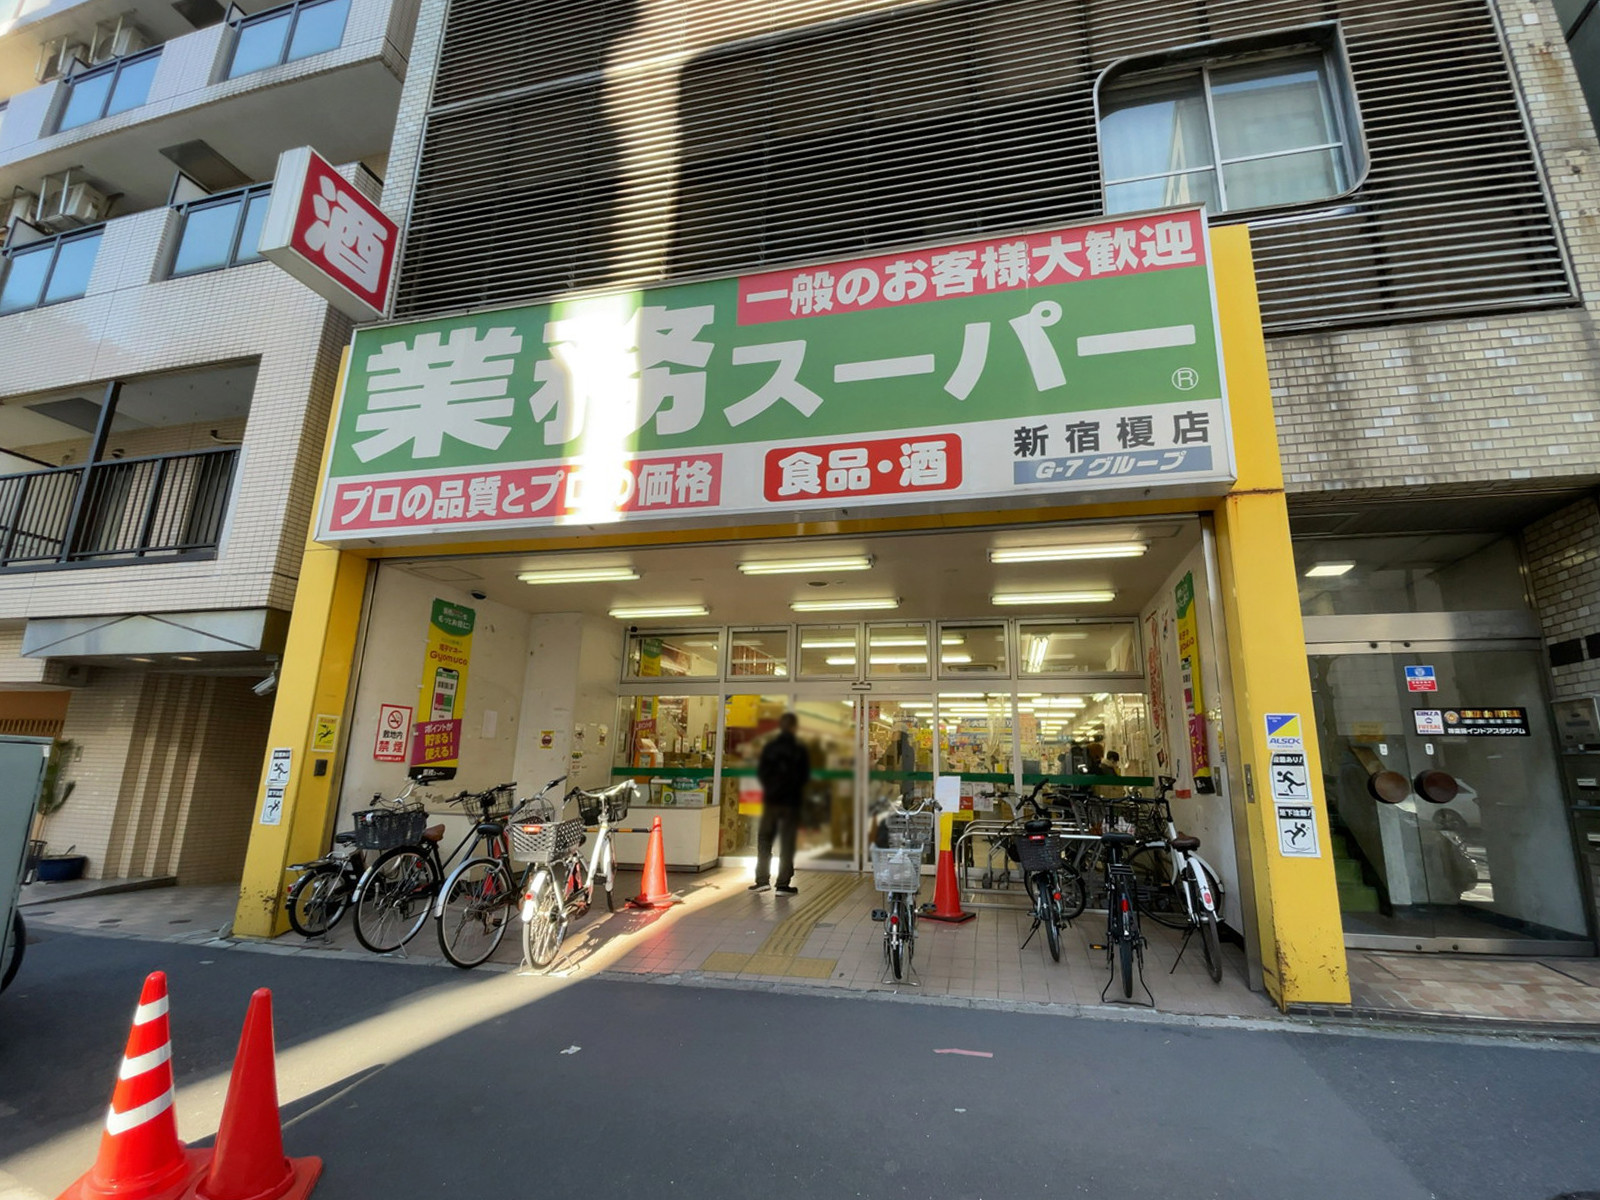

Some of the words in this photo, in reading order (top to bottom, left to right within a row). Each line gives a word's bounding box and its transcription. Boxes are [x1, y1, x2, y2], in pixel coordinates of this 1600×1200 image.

[304, 175, 388, 294] 酒
[745, 219, 1197, 317] 一般のお客様大歓迎
[351, 300, 1197, 463] 業務スーパー
[1013, 410, 1210, 458] 新宿榎店
[1035, 459, 1085, 479] G-7
[1086, 450, 1188, 476] グループ
